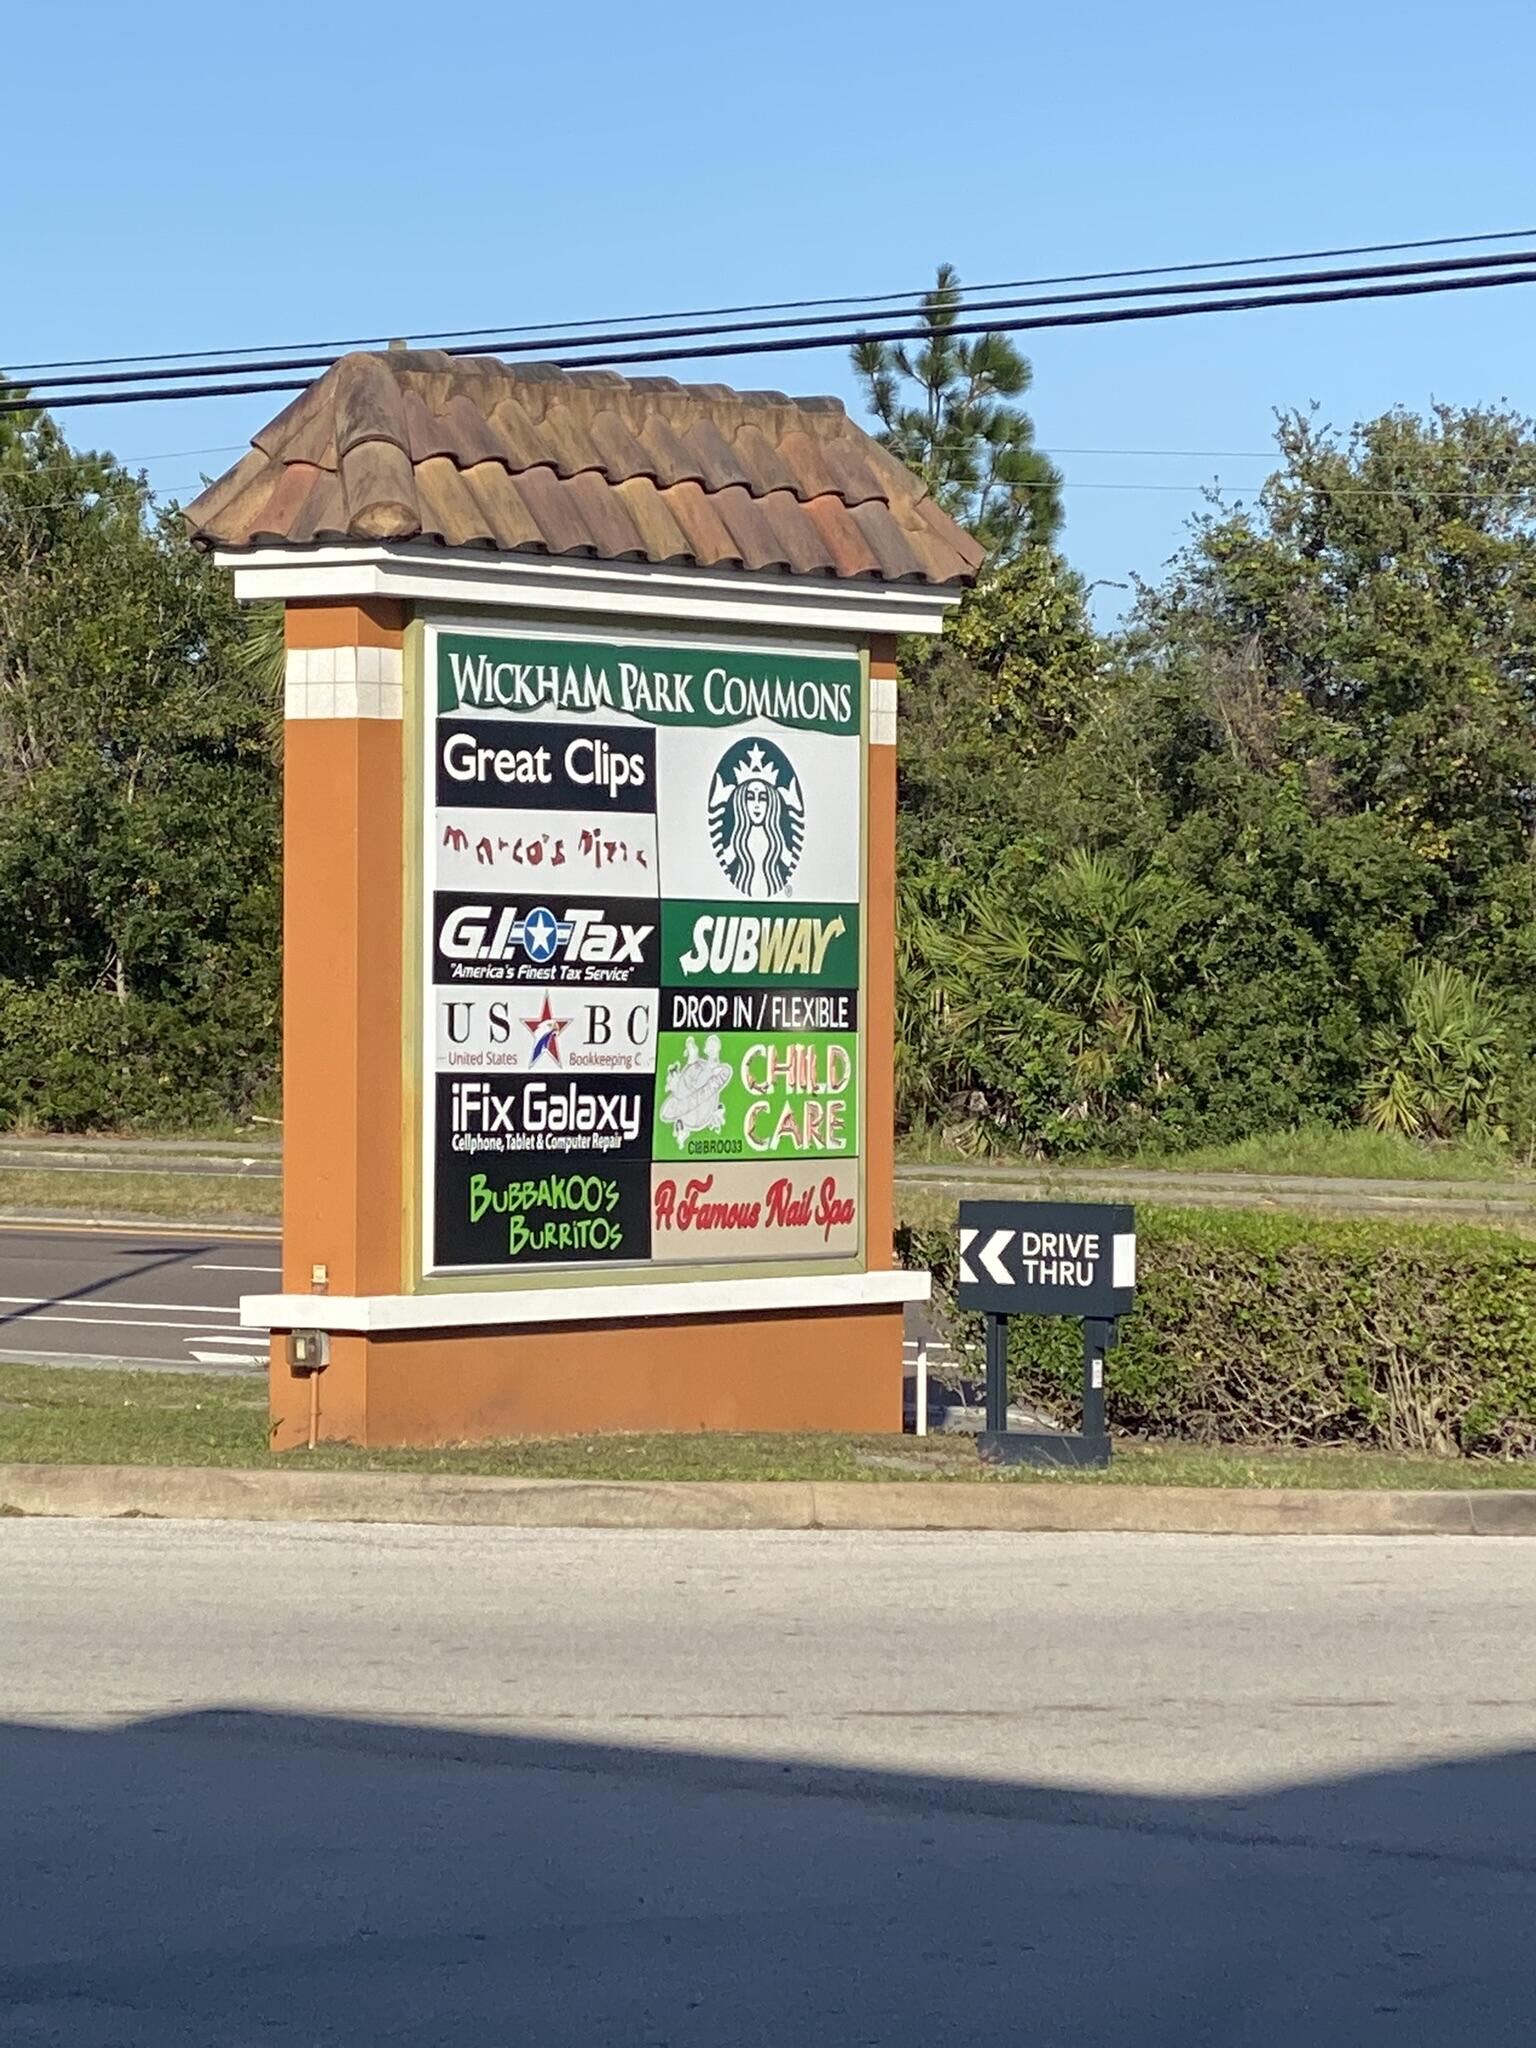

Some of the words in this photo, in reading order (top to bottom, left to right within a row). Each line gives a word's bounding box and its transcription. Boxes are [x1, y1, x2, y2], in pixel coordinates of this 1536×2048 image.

[443, 733, 552, 784] Great
[564, 738, 646, 798] Clips
[563, 909, 655, 963] Tax
[679, 914, 846, 977] SUBWAY
[516, 964, 556, 981] Finest
[559, 965, 581, 981] Tax
[672, 995, 729, 1029] DROP
[732, 996, 752, 1028] IN
[771, 996, 849, 1029] FLEXIBLE
[448, 1052, 483, 1066] United
[486, 1052, 518, 1066] States
[569, 1052, 632, 1070] Bookkeeping
[741, 1044, 851, 1096] CHILD
[452, 1082, 516, 1132] iFix
[522, 1082, 641, 1140] Galaxy
[744, 1101, 846, 1151] CARE
[452, 1134, 505, 1155] Cellphone,
[505, 1134, 536, 1150] Tablet
[536, 1135, 544, 1150] &
[545, 1134, 591, 1153] Computer
[591, 1132, 623, 1153] Repair
[654, 1179, 676, 1232] A
[676, 1174, 760, 1231] Famous
[764, 1178, 813, 1228] Nail
[814, 1176, 856, 1243] Spa
[1022, 1232, 1101, 1259] DRIVE
[1022, 1259, 1095, 1287] THRU
